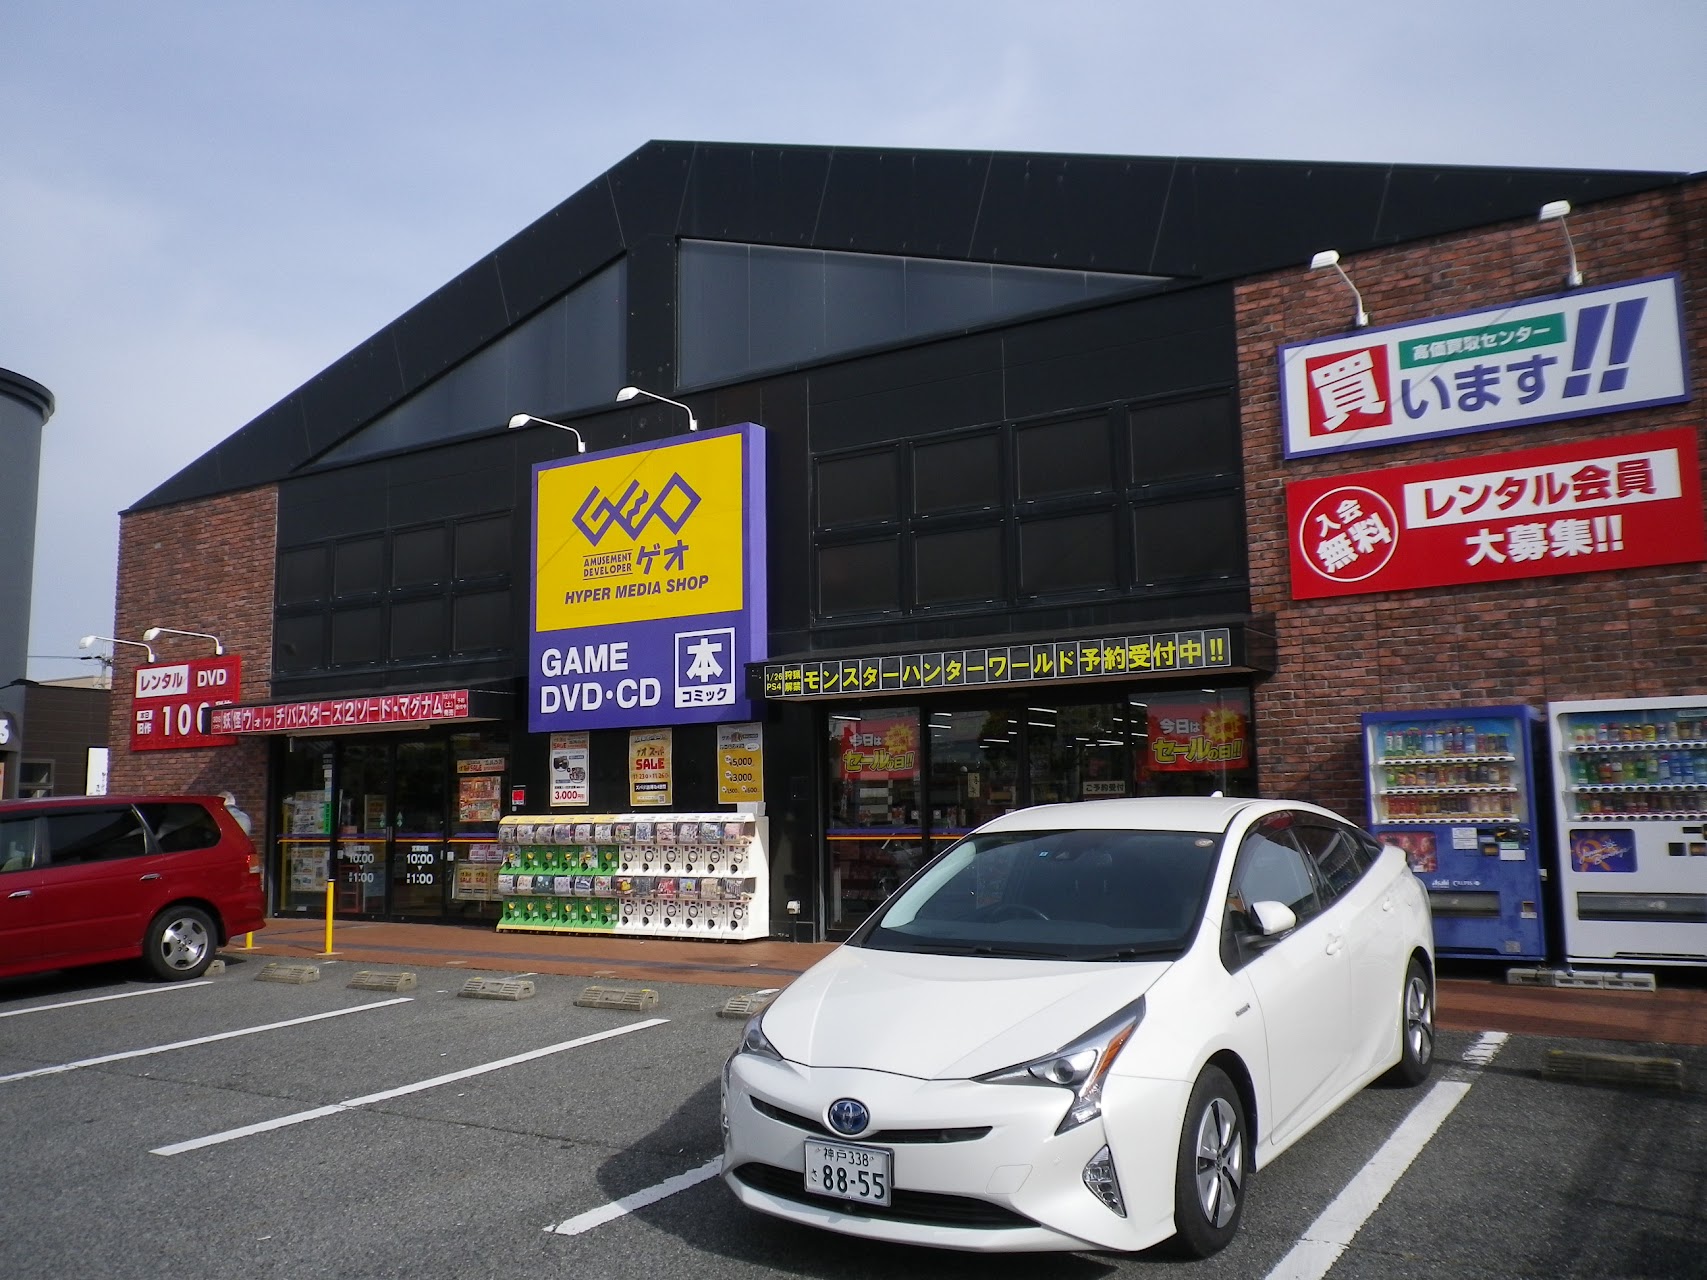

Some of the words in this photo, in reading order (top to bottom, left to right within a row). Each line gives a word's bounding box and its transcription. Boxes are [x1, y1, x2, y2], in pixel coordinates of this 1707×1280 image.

[1413, 326, 1550, 361] 高価買取センター
[1424, 458, 1656, 520] レンタル会員
[571, 471, 702, 547] GEO
[1315, 499, 1364, 538] 入会
[1316, 511, 1393, 574] 無料
[1465, 514, 1624, 567] 大募集!!
[583, 552, 632, 567] AMUSEMENT
[636, 539, 690, 575] ゲオ
[583, 563, 632, 578] DEVELOPER
[564, 587, 611, 605] HYPER
[615, 581, 661, 599] MEDIA
[666, 575, 709, 593] SHOP
[541, 641, 629, 678] GAME
[686, 637, 723, 683] 本
[803, 637, 1225, 691] モンスターハンターワールド予約受付中!!
[140, 672, 183, 691] レンタル
[197, 668, 227, 687] DVD
[766, 672, 783, 682] 1/26
[766, 683, 782, 691] PS4
[784, 681, 801, 692] 解禁
[681, 686, 728, 704] コミック
[1159, 718, 1201, 735] 今日は
[848, 733, 882, 748] 今日は
[1151, 734, 1244, 764] セールの日!!
[635, 757, 665, 771] SALE
[842, 748, 916, 772] セールの日!!
[1085, 781, 1125, 793] ご予約受付
[349, 853, 375, 864] 10:00
[406, 853, 434, 865] 10:00
[822, 1164, 886, 1200] 88-55
